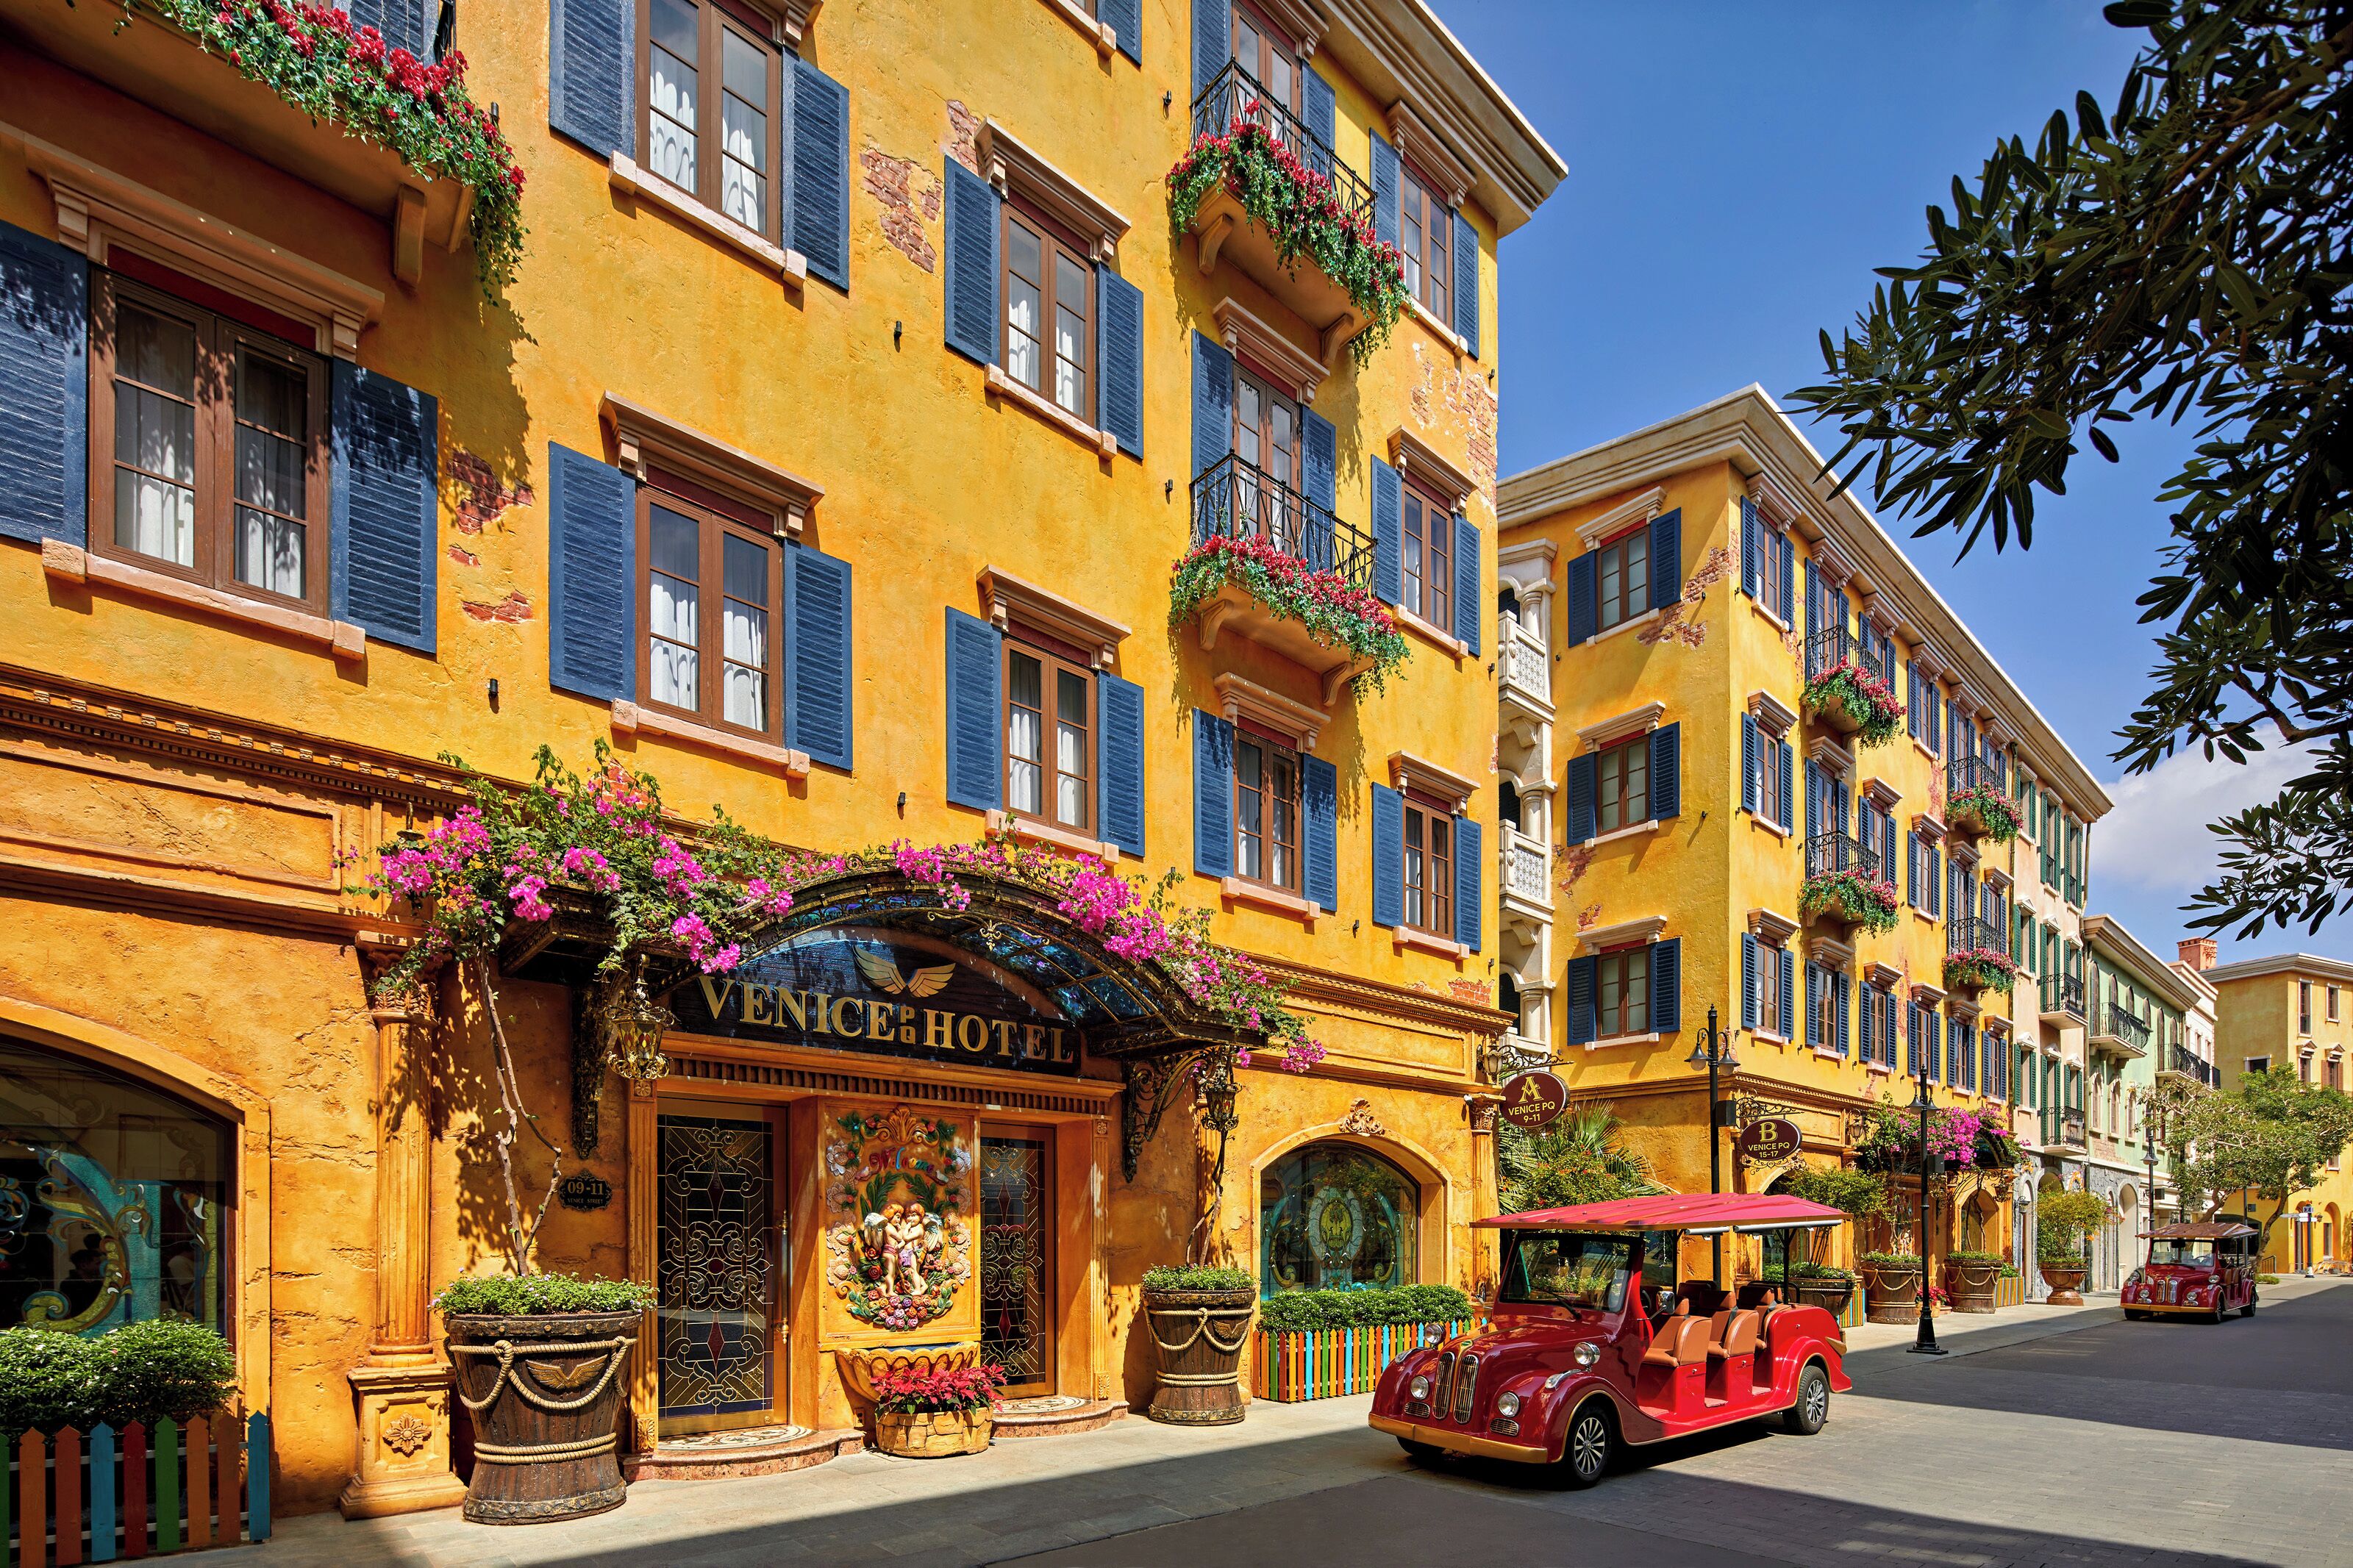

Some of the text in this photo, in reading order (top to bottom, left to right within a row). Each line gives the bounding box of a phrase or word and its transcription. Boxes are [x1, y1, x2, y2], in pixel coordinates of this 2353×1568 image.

[699, 975, 895, 1041] VENICE
[923, 1008, 1074, 1064] HOTEL
[1518, 1076, 1544, 1103] A
[1508, 1101, 1555, 1116] VENICE PQ
[1524, 1114, 1540, 1123] 9-11
[1759, 1121, 1778, 1142] B
[1748, 1143, 1777, 1151] VENICE
